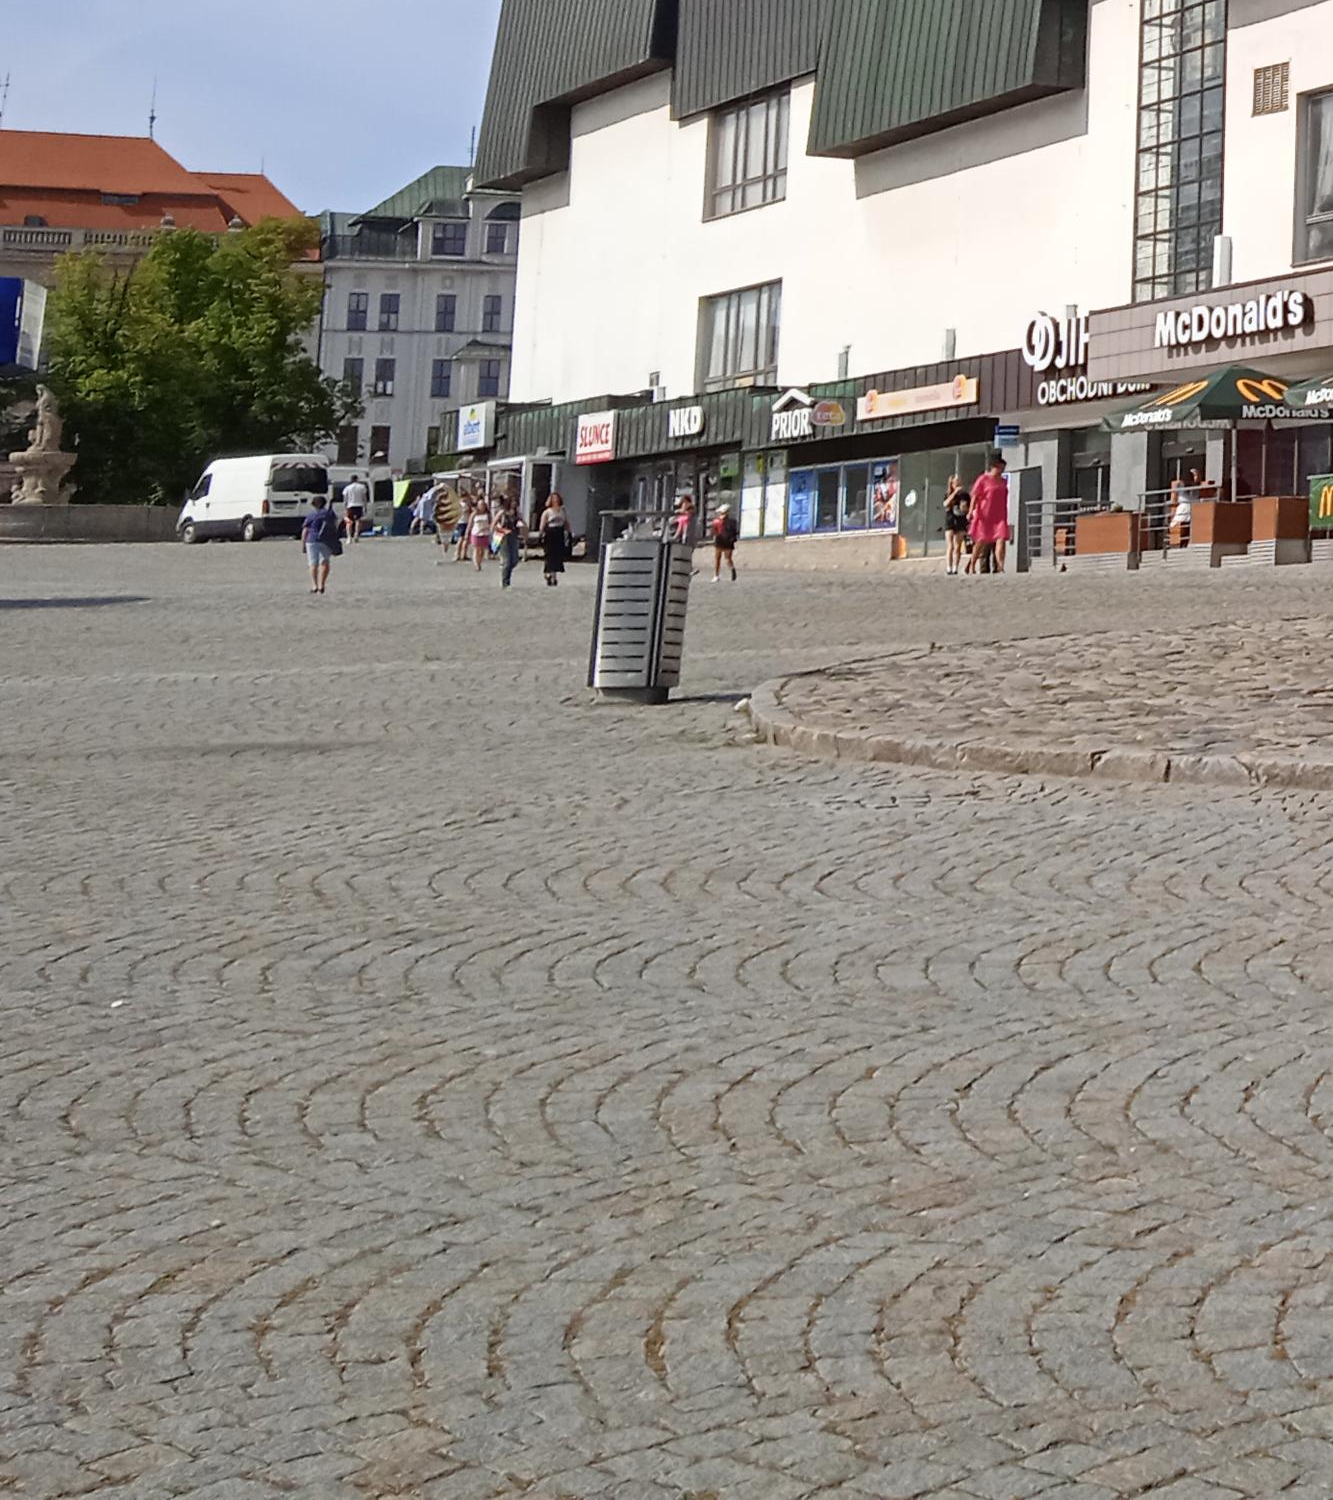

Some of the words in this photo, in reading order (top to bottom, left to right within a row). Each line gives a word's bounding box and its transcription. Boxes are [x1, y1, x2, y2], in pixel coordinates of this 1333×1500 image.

[1154, 290, 1305, 348] McDonald's
[669, 406, 704, 438] NKD
[770, 407, 813, 441] PRIOR
[1120, 408, 1174, 428] McDonald's
[579, 423, 611, 448] SLUNCE
